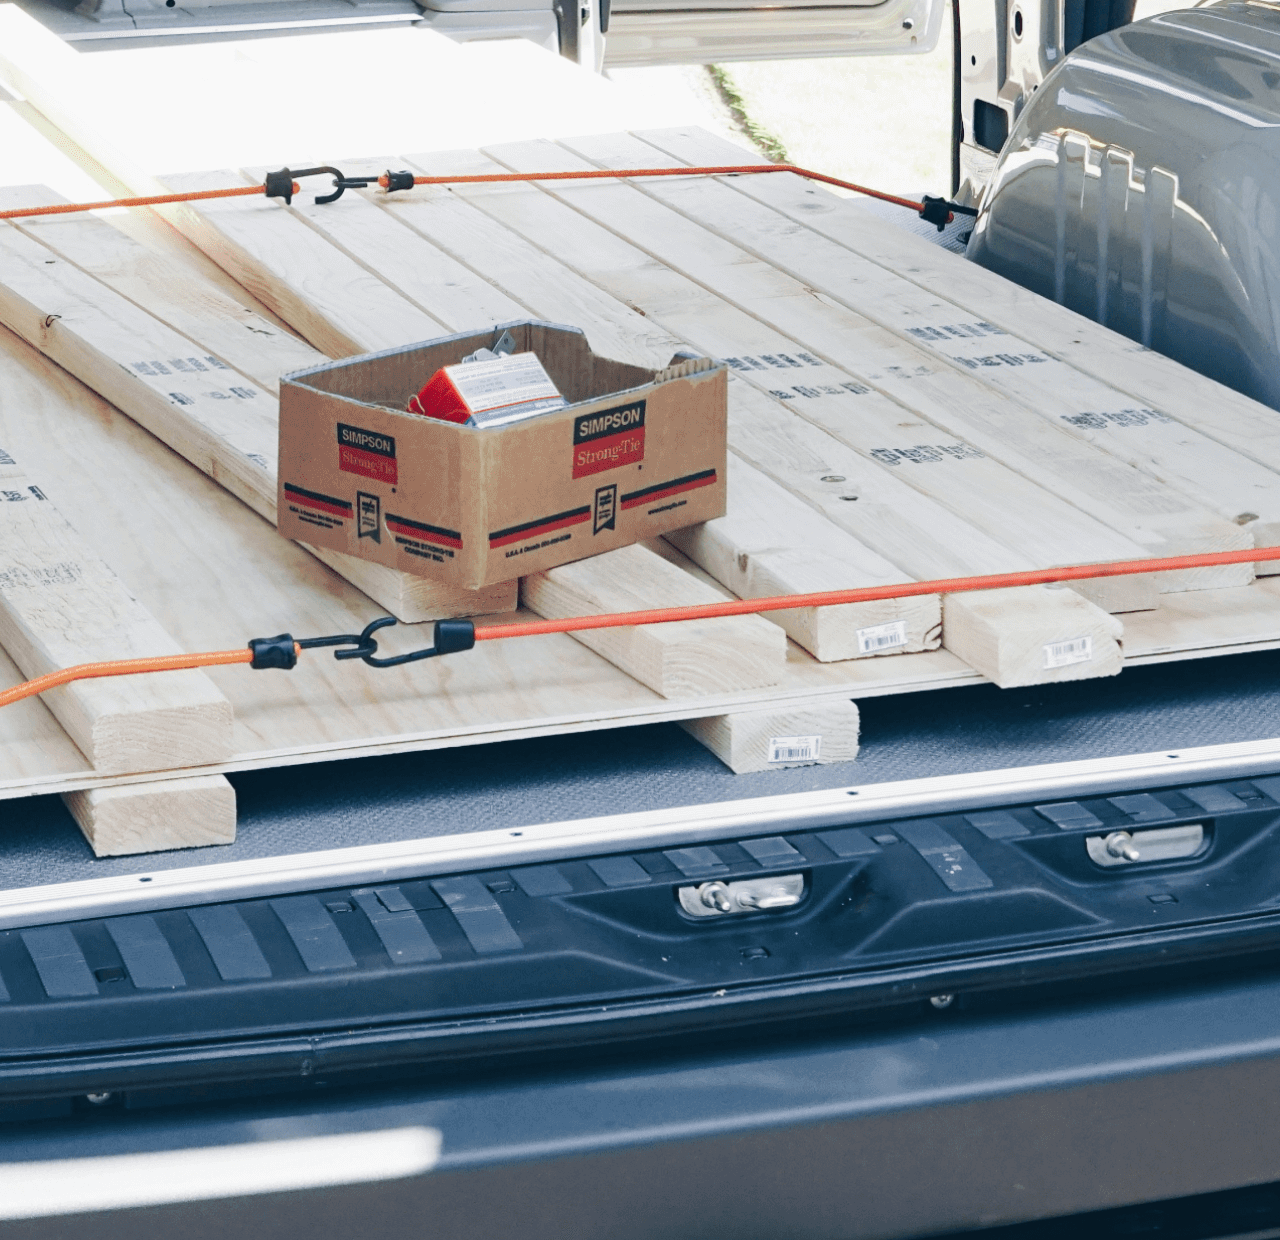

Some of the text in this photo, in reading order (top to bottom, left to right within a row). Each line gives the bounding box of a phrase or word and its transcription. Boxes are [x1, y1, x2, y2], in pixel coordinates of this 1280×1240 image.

[579, 408, 641, 437] SIMPSON
[342, 429, 391, 452] SIMPSON
[577, 438, 641, 466] Strong-Tie
[343, 451, 395, 474] Strong-Tie
